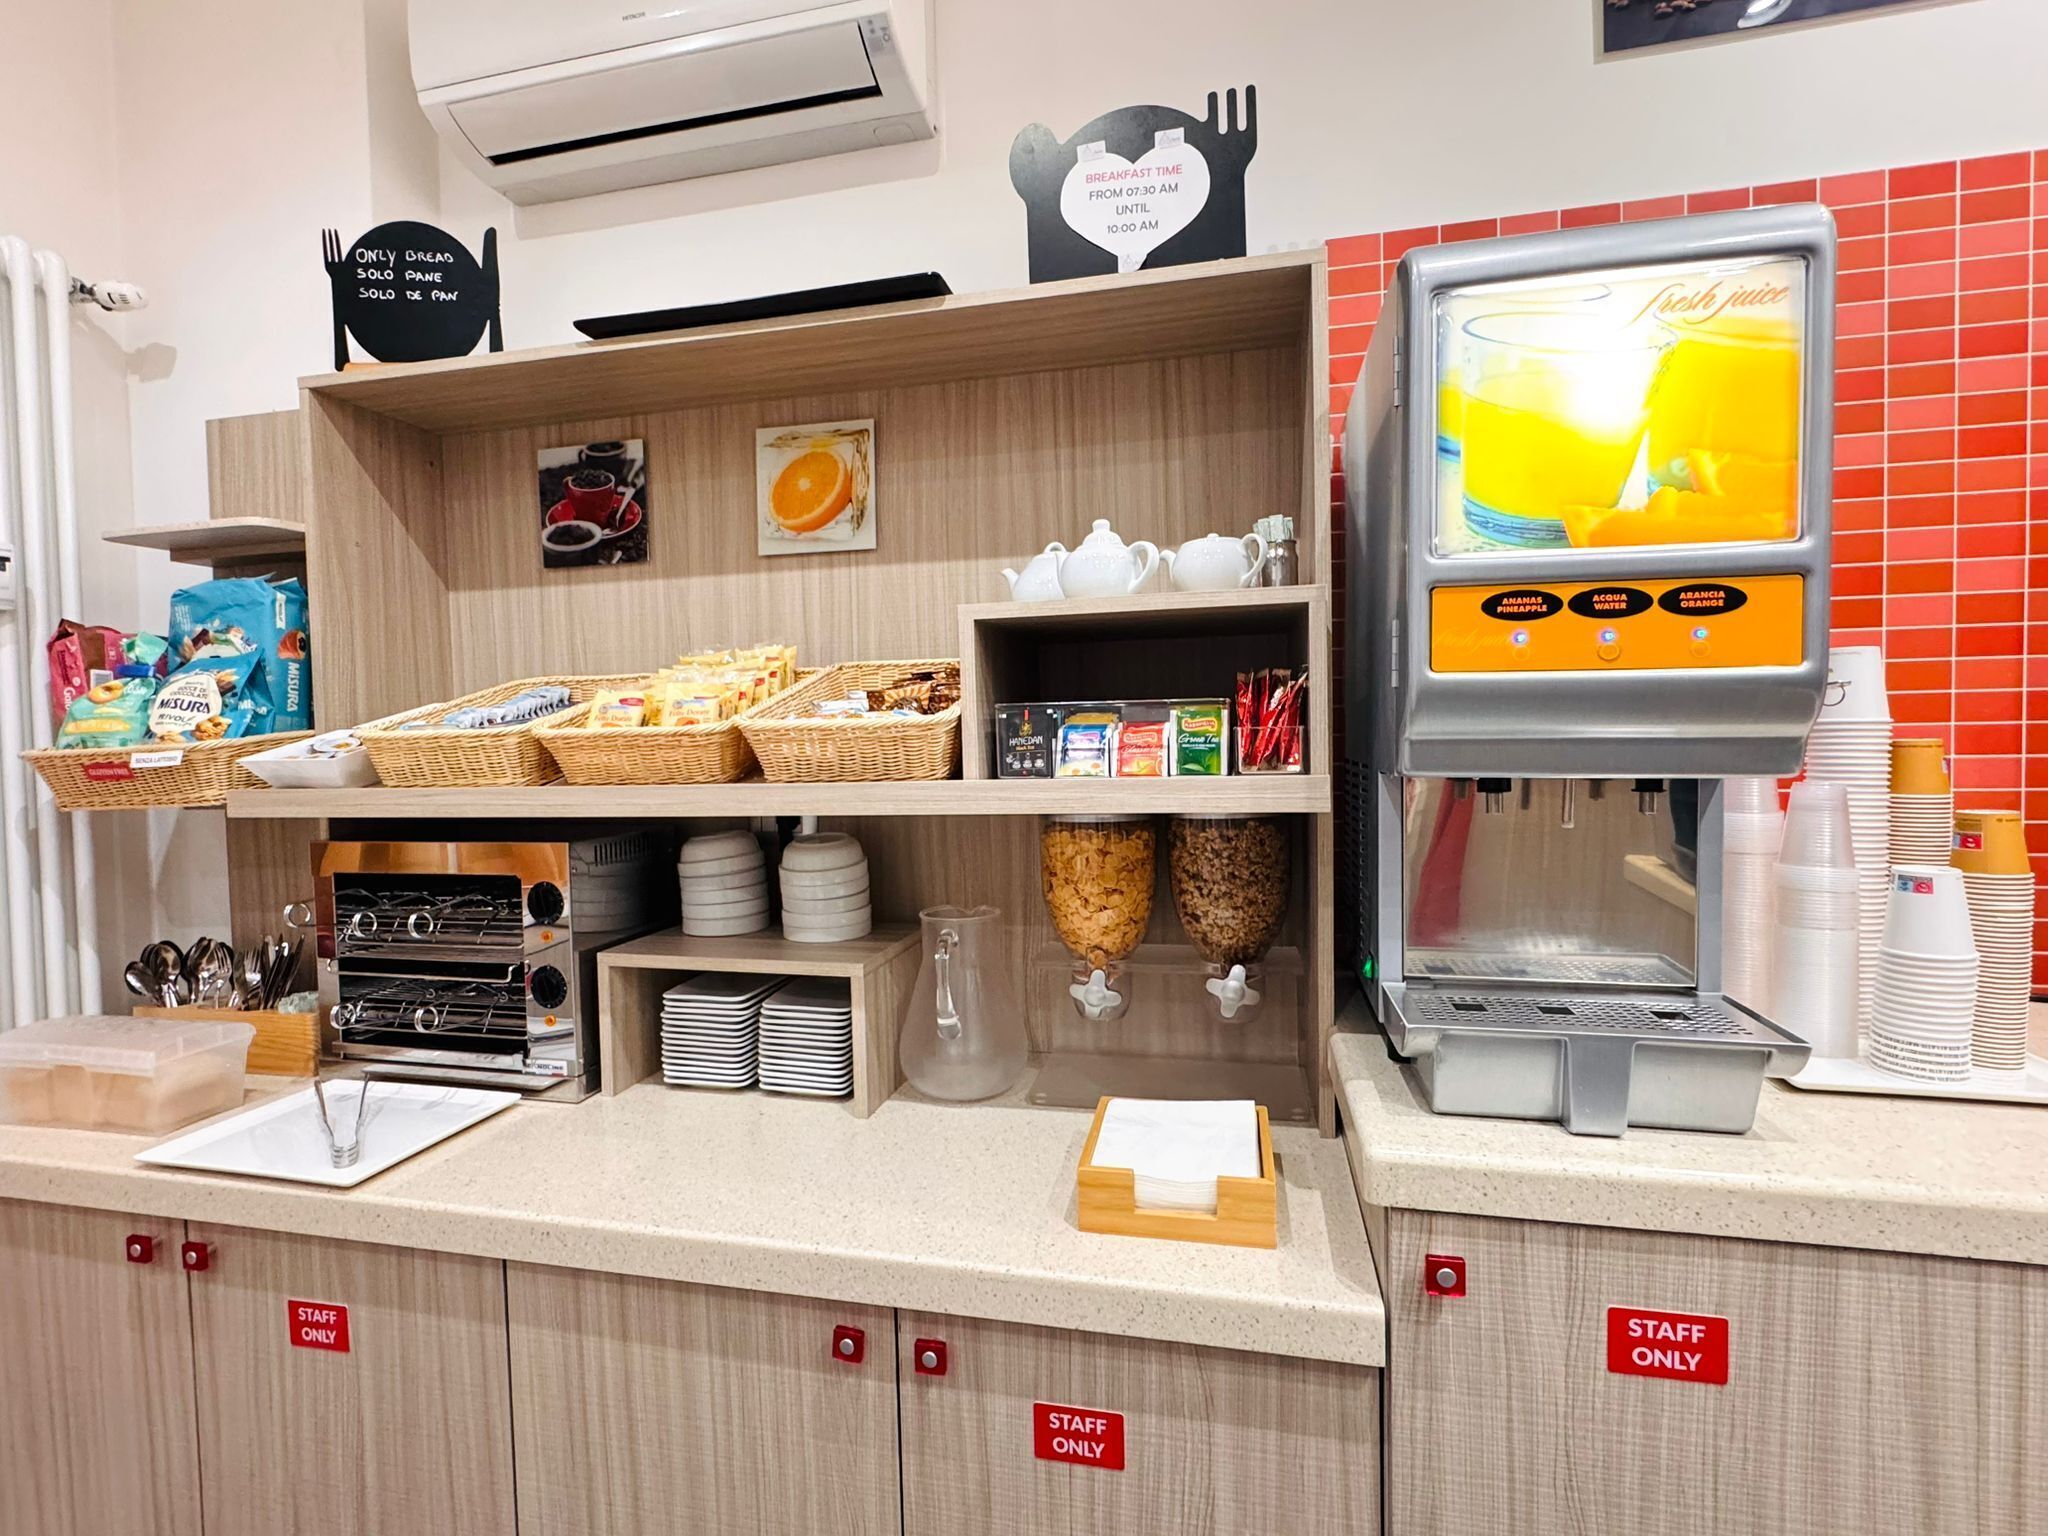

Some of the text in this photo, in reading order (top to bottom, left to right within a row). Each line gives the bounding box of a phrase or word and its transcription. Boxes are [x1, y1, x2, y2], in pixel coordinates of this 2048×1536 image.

[622, 11, 646, 21] HITACHI
[1085, 164, 1183, 184] BREAKFAST TIME
[1089, 182, 1179, 201] FROM 07:30 AM
[1116, 203, 1151, 216] UNTIL
[1107, 220, 1159, 234] 10:00 AM
[355, 248, 454, 268] ONLY BREAD
[357, 268, 443, 283] SOLO PANE
[358, 287, 458, 301] SOLO DE PAN
[1626, 280, 1790, 329] fresh juice
[1502, 597, 1542, 605] ANANAS
[1592, 593, 1628, 602] ACQUA
[1678, 590, 1726, 600] ARANCIA
[1497, 605, 1547, 613] PINEAPPLE
[1594, 602, 1627, 610] WATER
[1680, 599, 1724, 608] ORANGE
[1009, 736, 1043, 747] HANEDAN
[1178, 733, 1203, 744] Green
[298, 1307, 337, 1325] STAFF
[301, 1327, 336, 1345] ONLY
[1628, 1318, 1706, 1343] STAFF
[1631, 1347, 1702, 1371] ONLY
[1049, 1412, 1107, 1435] STAFF
[1052, 1437, 1105, 1459] ONLY
